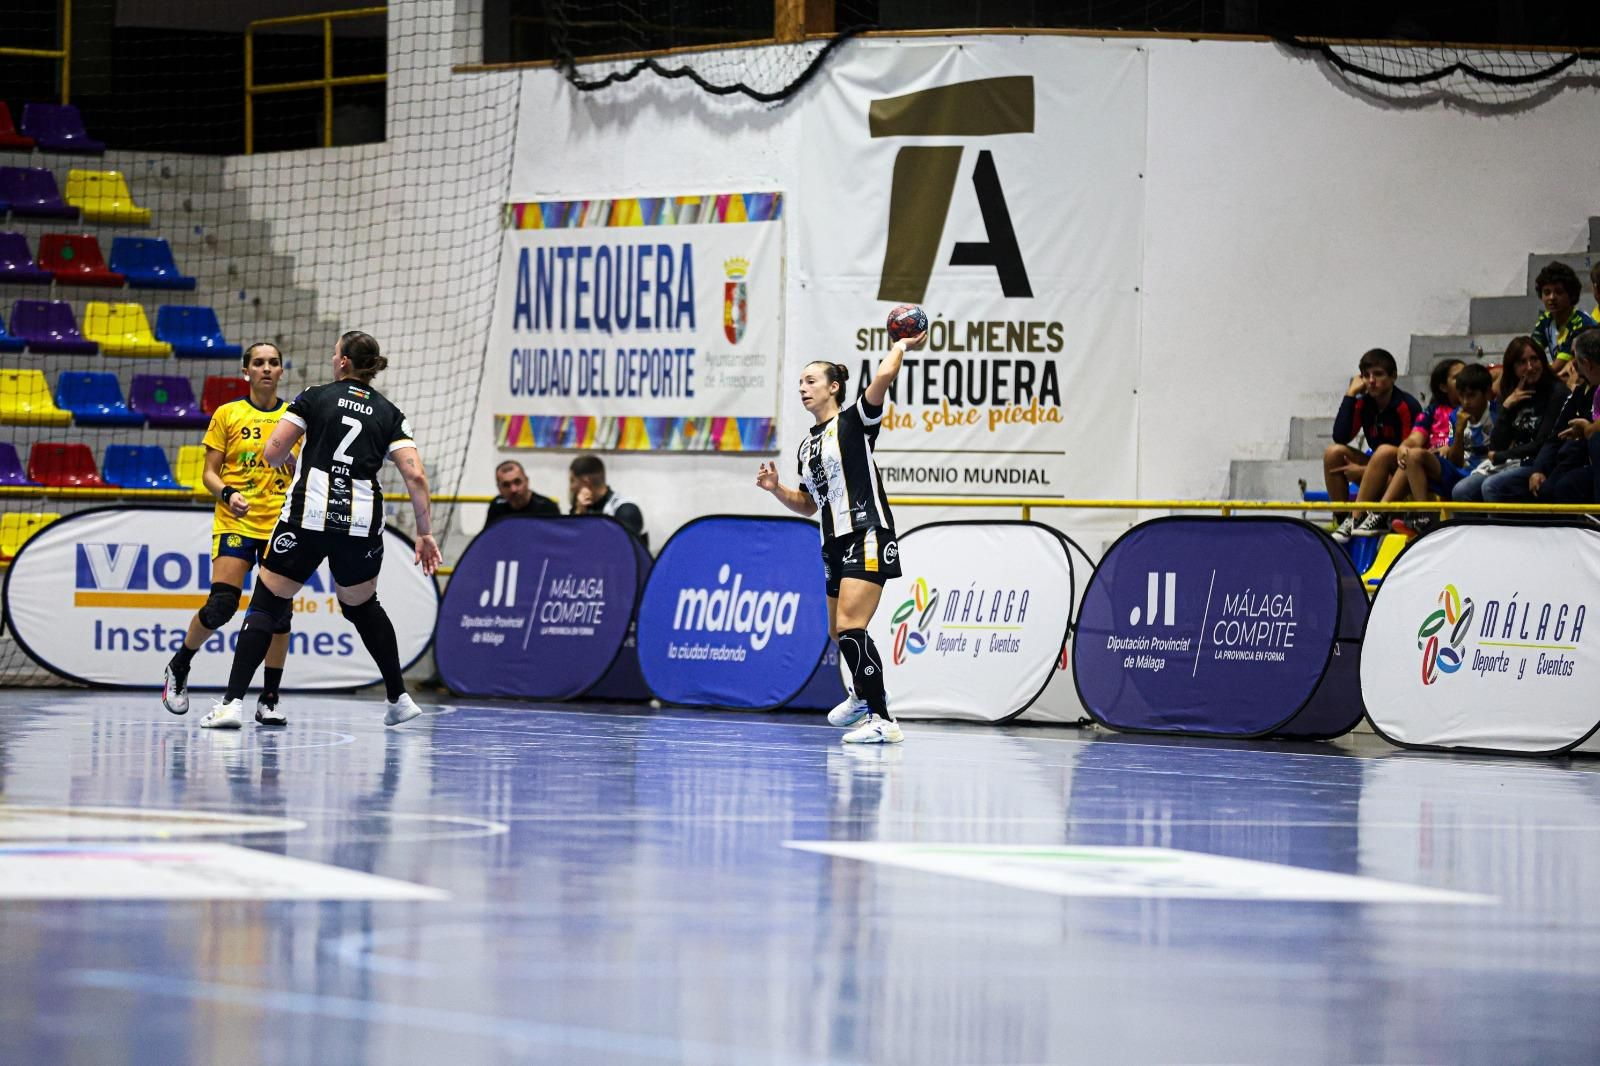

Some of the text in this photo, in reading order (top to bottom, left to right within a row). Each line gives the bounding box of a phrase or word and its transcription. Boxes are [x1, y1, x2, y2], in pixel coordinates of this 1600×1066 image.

[513, 243, 696, 337] ANTEQUERA
[510, 348, 696, 398] CIUDAD DEL DEPORTE
[338, 397, 373, 416] BITOLO
[922, 395, 981, 432] sobre
[988, 397, 1064, 432] piedra
[241, 427, 262, 440] 93
[333, 415, 362, 464] 2
[878, 466, 1051, 485] TRIMONIO MUNDIAL
[277, 537, 298, 549] CSIF
[551, 574, 603, 599] MÁLAGA
[541, 602, 605, 624] COMPITE
[673, 563, 800, 651] málaga
[943, 581, 1030, 623] MÁLAGA
[1223, 588, 1293, 617] MÁLAGA
[1480, 591, 1586, 642] MÁLAGA
[94, 620, 354, 656] Instaacnes
[936, 632, 1021, 657] Deporte y Eventos
[1107, 635, 1191, 652] Diputación Provincial
[1213, 620, 1297, 648] COMPITE
[668, 642, 747, 662] la ciudad redonda
[1124, 654, 1165, 672] de Málaga
[1215, 650, 1285, 661] LA PROVINCIA EN FORMA
[1472, 648, 1575, 680] Deporte y Eventos
